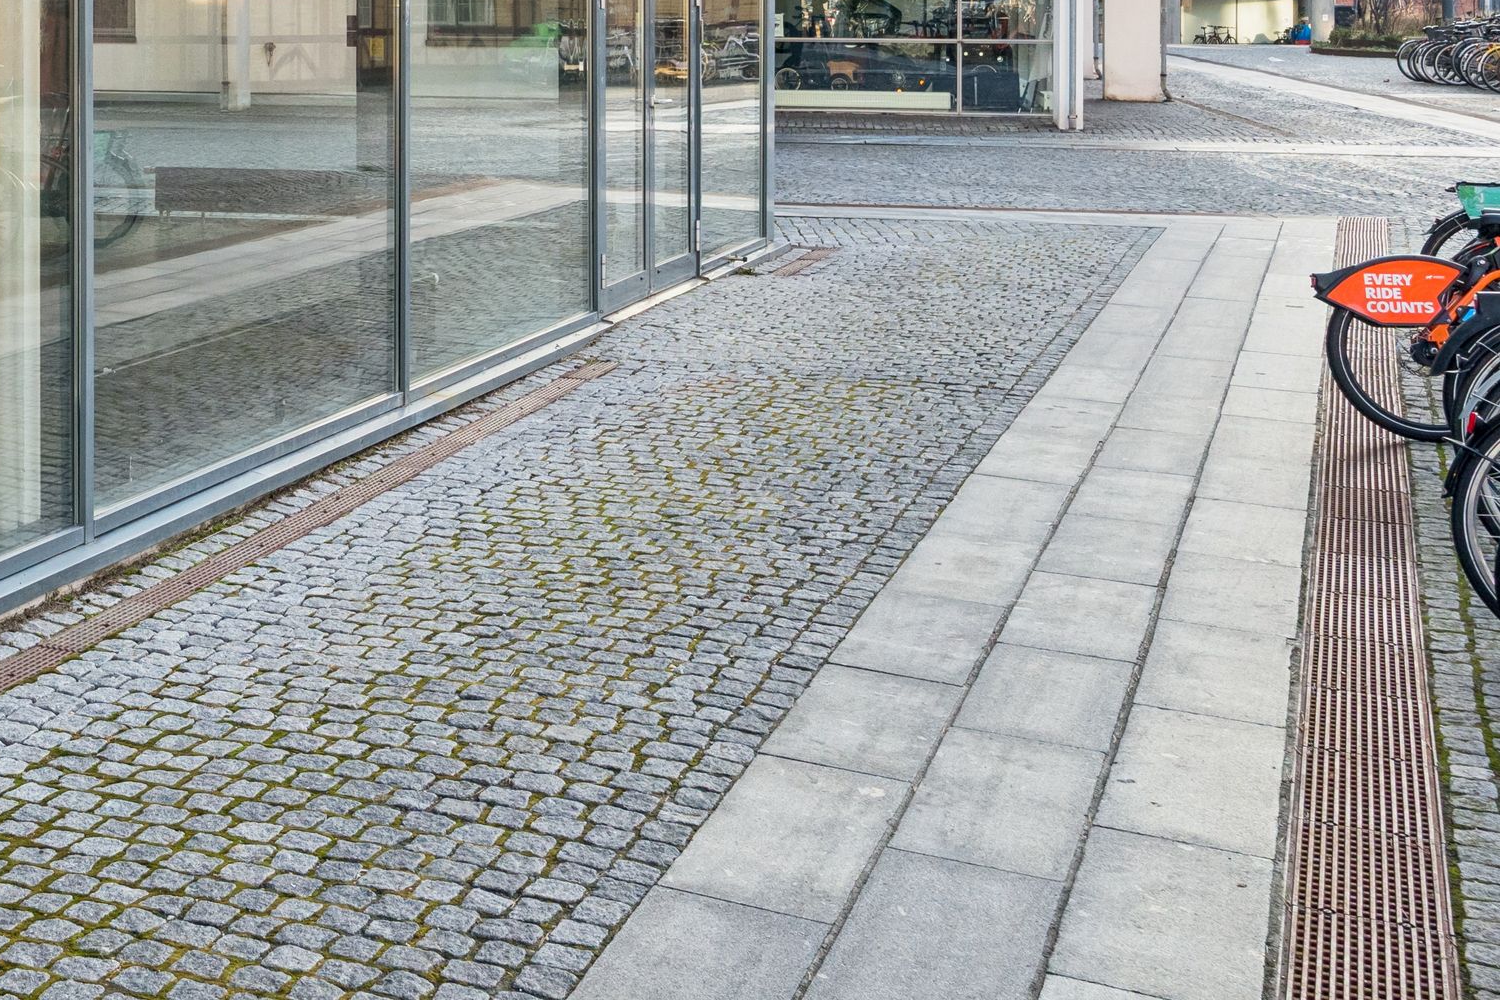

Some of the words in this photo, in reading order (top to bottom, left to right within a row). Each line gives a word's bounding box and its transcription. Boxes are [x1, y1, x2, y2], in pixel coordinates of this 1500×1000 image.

[1363, 273, 1413, 286] EVERY
[1365, 287, 1402, 300] RIDE
[1366, 301, 1435, 314] COUNTS
